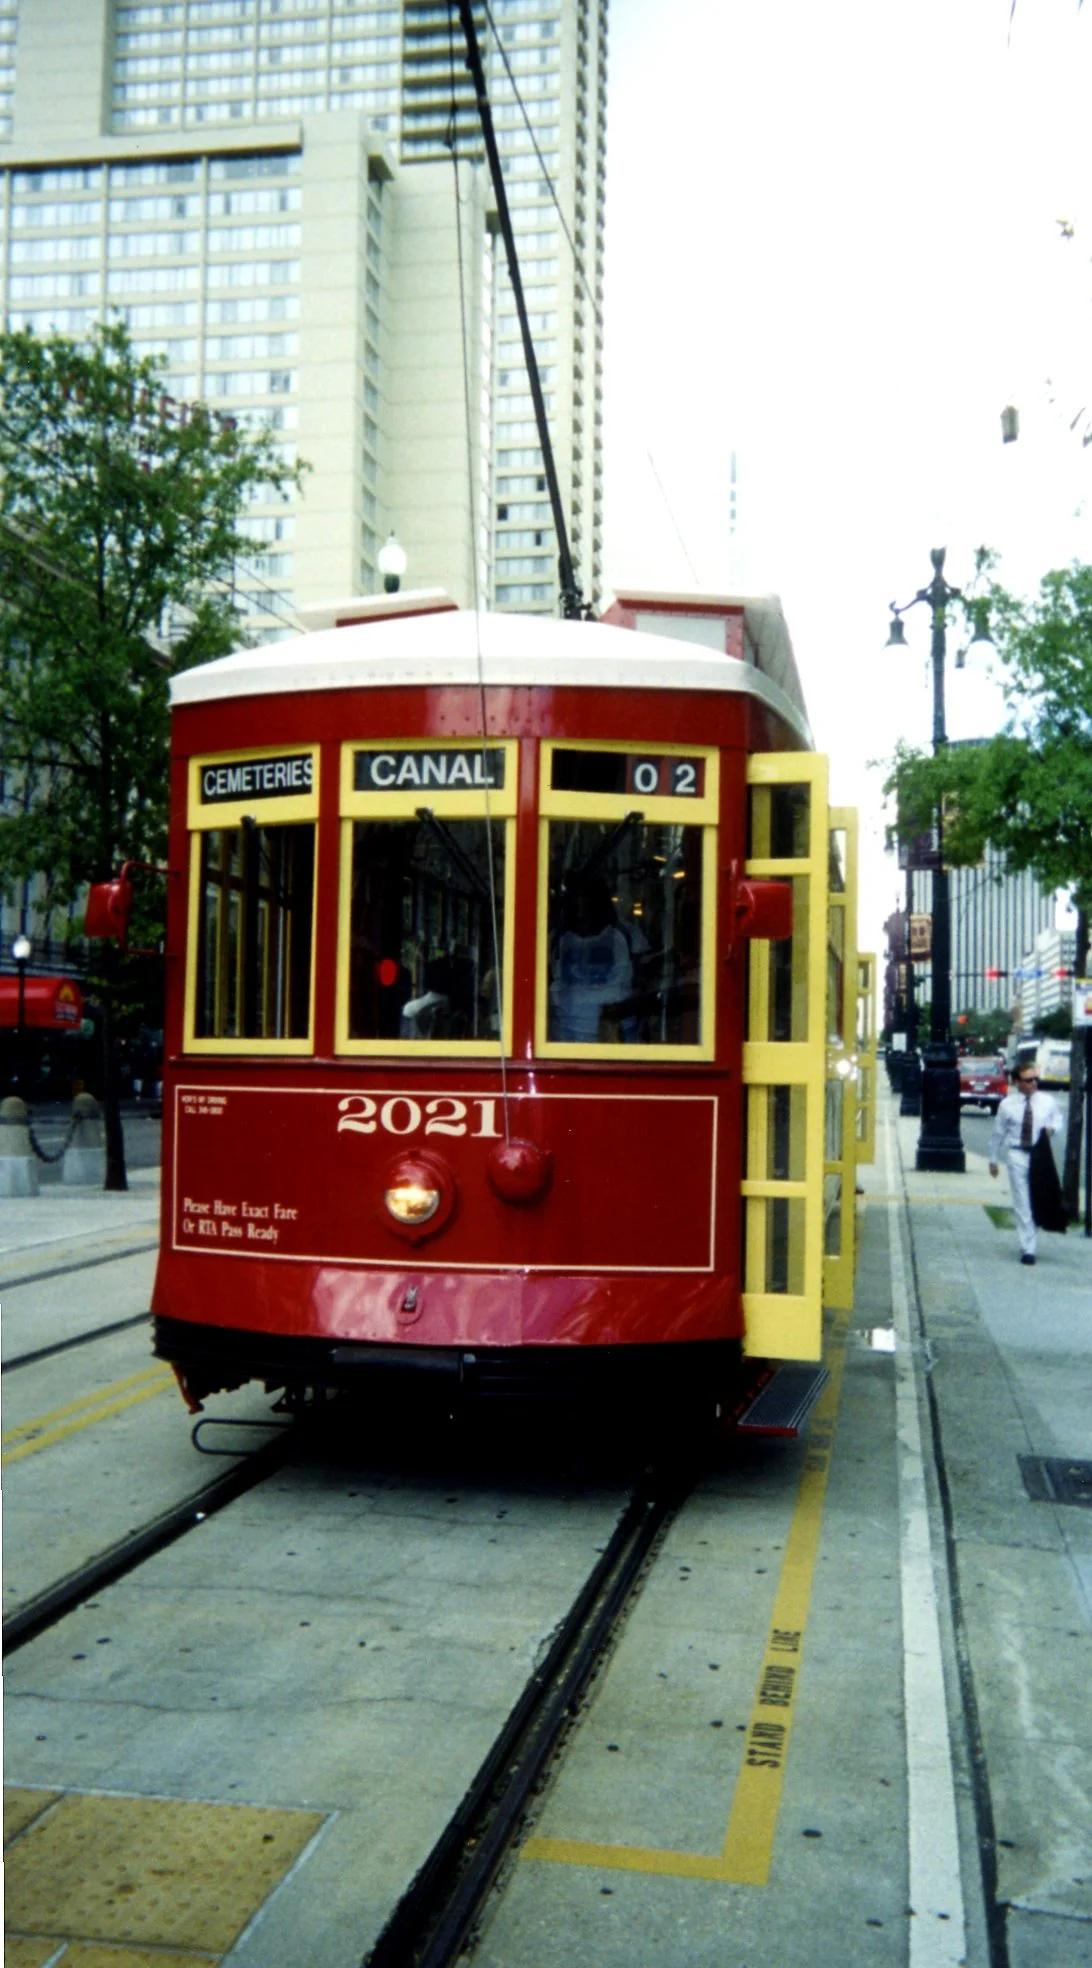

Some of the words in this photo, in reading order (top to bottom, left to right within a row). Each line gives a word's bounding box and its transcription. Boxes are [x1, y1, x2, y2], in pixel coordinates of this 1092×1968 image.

[203, 758, 312, 796] CEMETERIES
[370, 755, 495, 787] CANAL
[337, 1096, 503, 1138] 2021
[183, 1197, 210, 1214] Please
[214, 1200, 237, 1216] Have
[241, 1201, 269, 1218] Exact
[273, 1203, 298, 1220] Fare
[183, 1218, 195, 1233] Or
[199, 1220, 217, 1236] RTA
[221, 1221, 243, 1237] Pass
[247, 1223, 279, 1245] Ready
[770, 1629, 801, 1652] LINE
[759, 1665, 796, 1707] BEHIND
[746, 1722, 786, 1768] STAND
